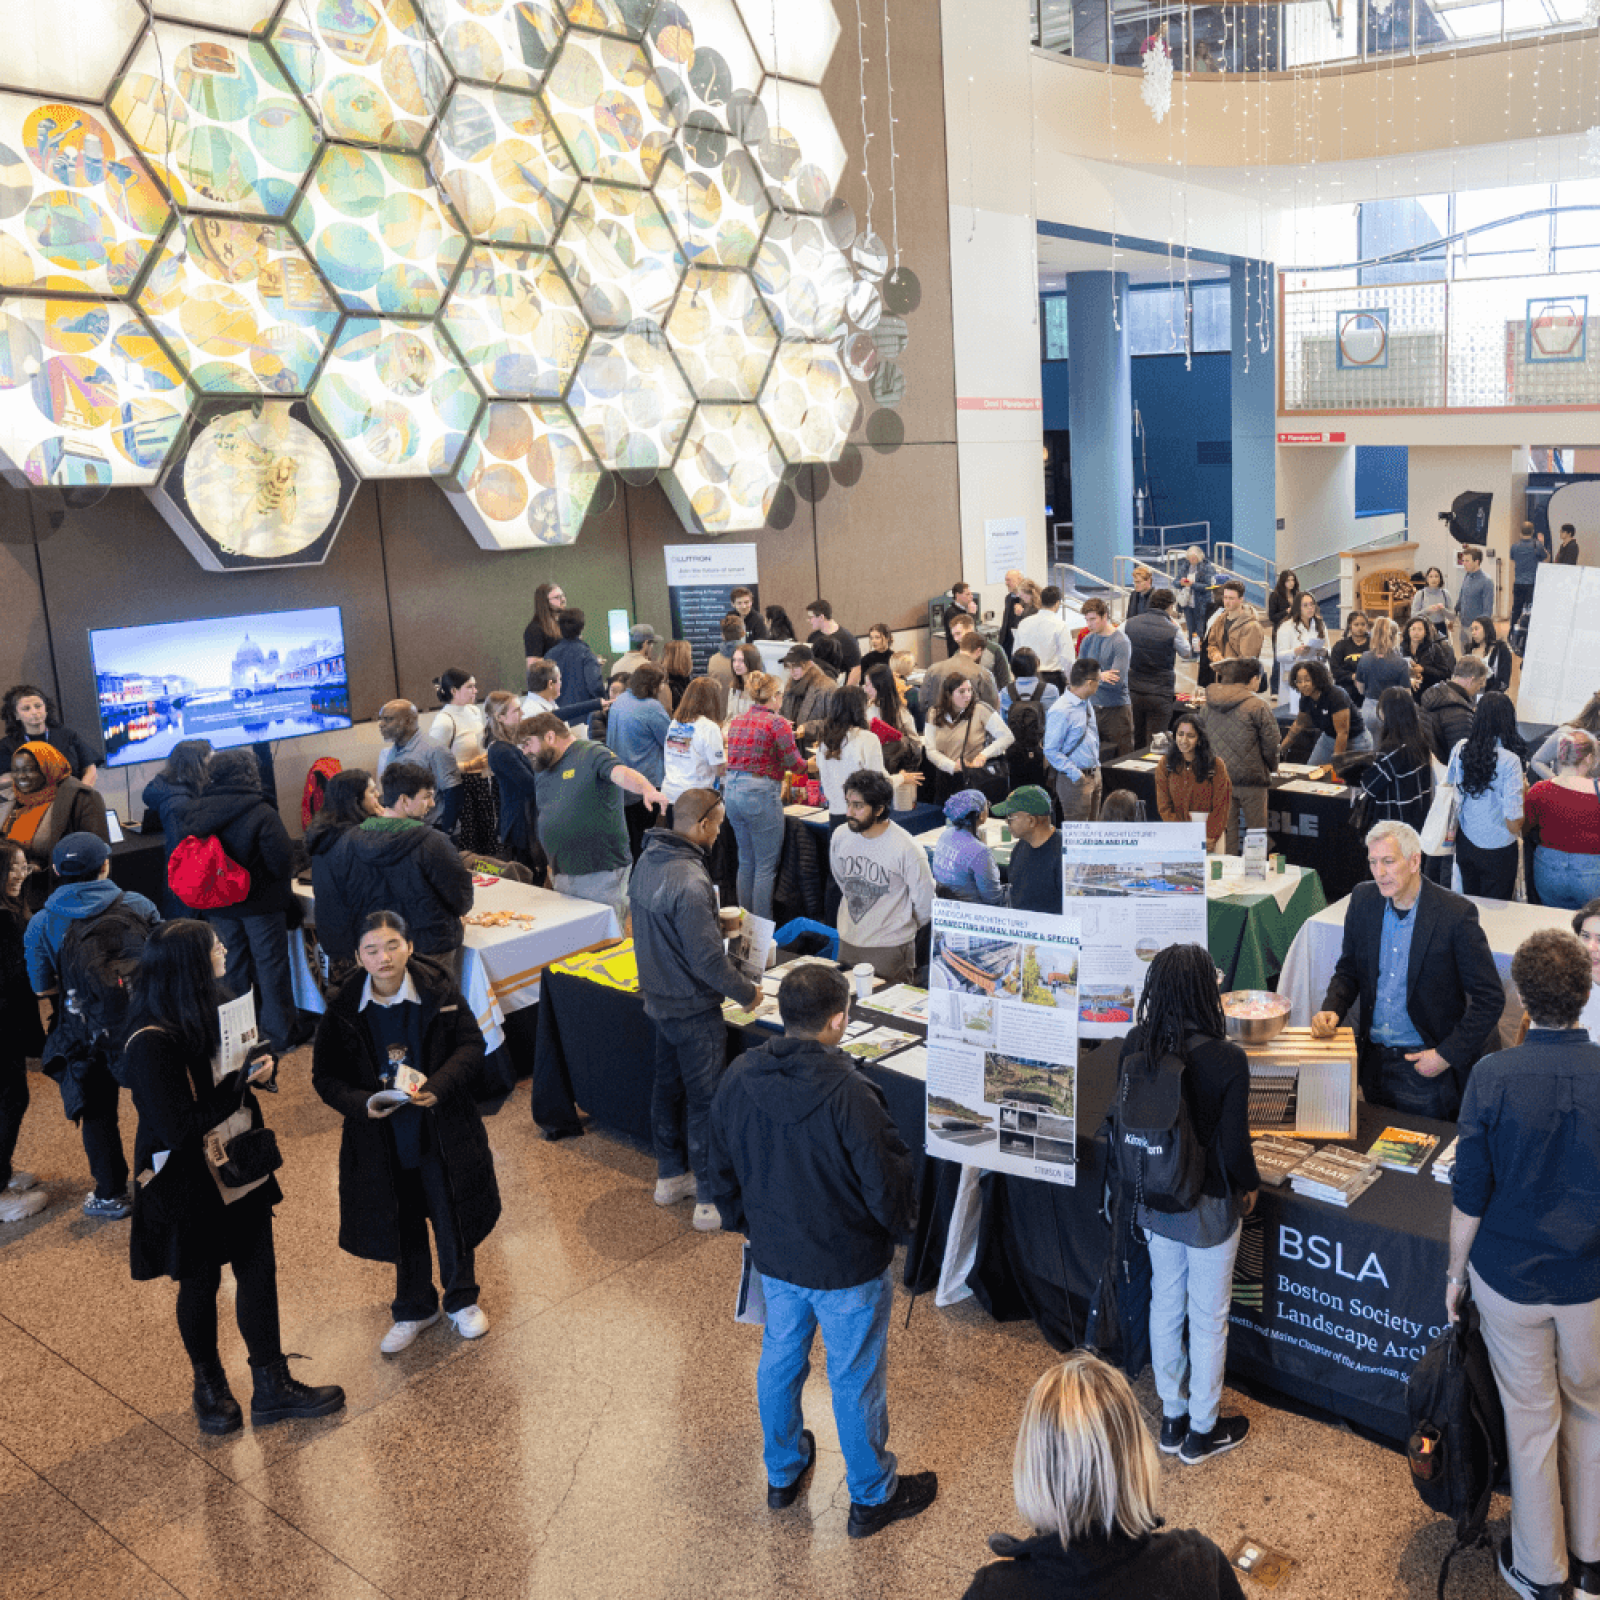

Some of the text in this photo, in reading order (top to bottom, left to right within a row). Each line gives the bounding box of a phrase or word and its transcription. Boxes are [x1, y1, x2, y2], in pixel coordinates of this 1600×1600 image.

[934, 908, 973, 920] LANDSCAPE
[934, 917, 979, 931] CONNECTING
[979, 923, 1009, 937] HUMAN,
[1009, 928, 1038, 940] NATURE
[1047, 933, 1080, 945] SPECIES
[1301, 1160, 1351, 1182] CLIMATE
[1279, 1224, 1390, 1289] BSLA
[1276, 1301, 1379, 1353] Landscape
[1277, 1274, 1345, 1312] Boston
[1349, 1298, 1424, 1339] Society
[1270, 1328, 1299, 1345] Maine
[1298, 1338, 1332, 1358] Chapter
[1332, 1351, 1343, 1364] of
[1342, 1354, 1356, 1369] the
[1355, 1362, 1400, 1380] American
